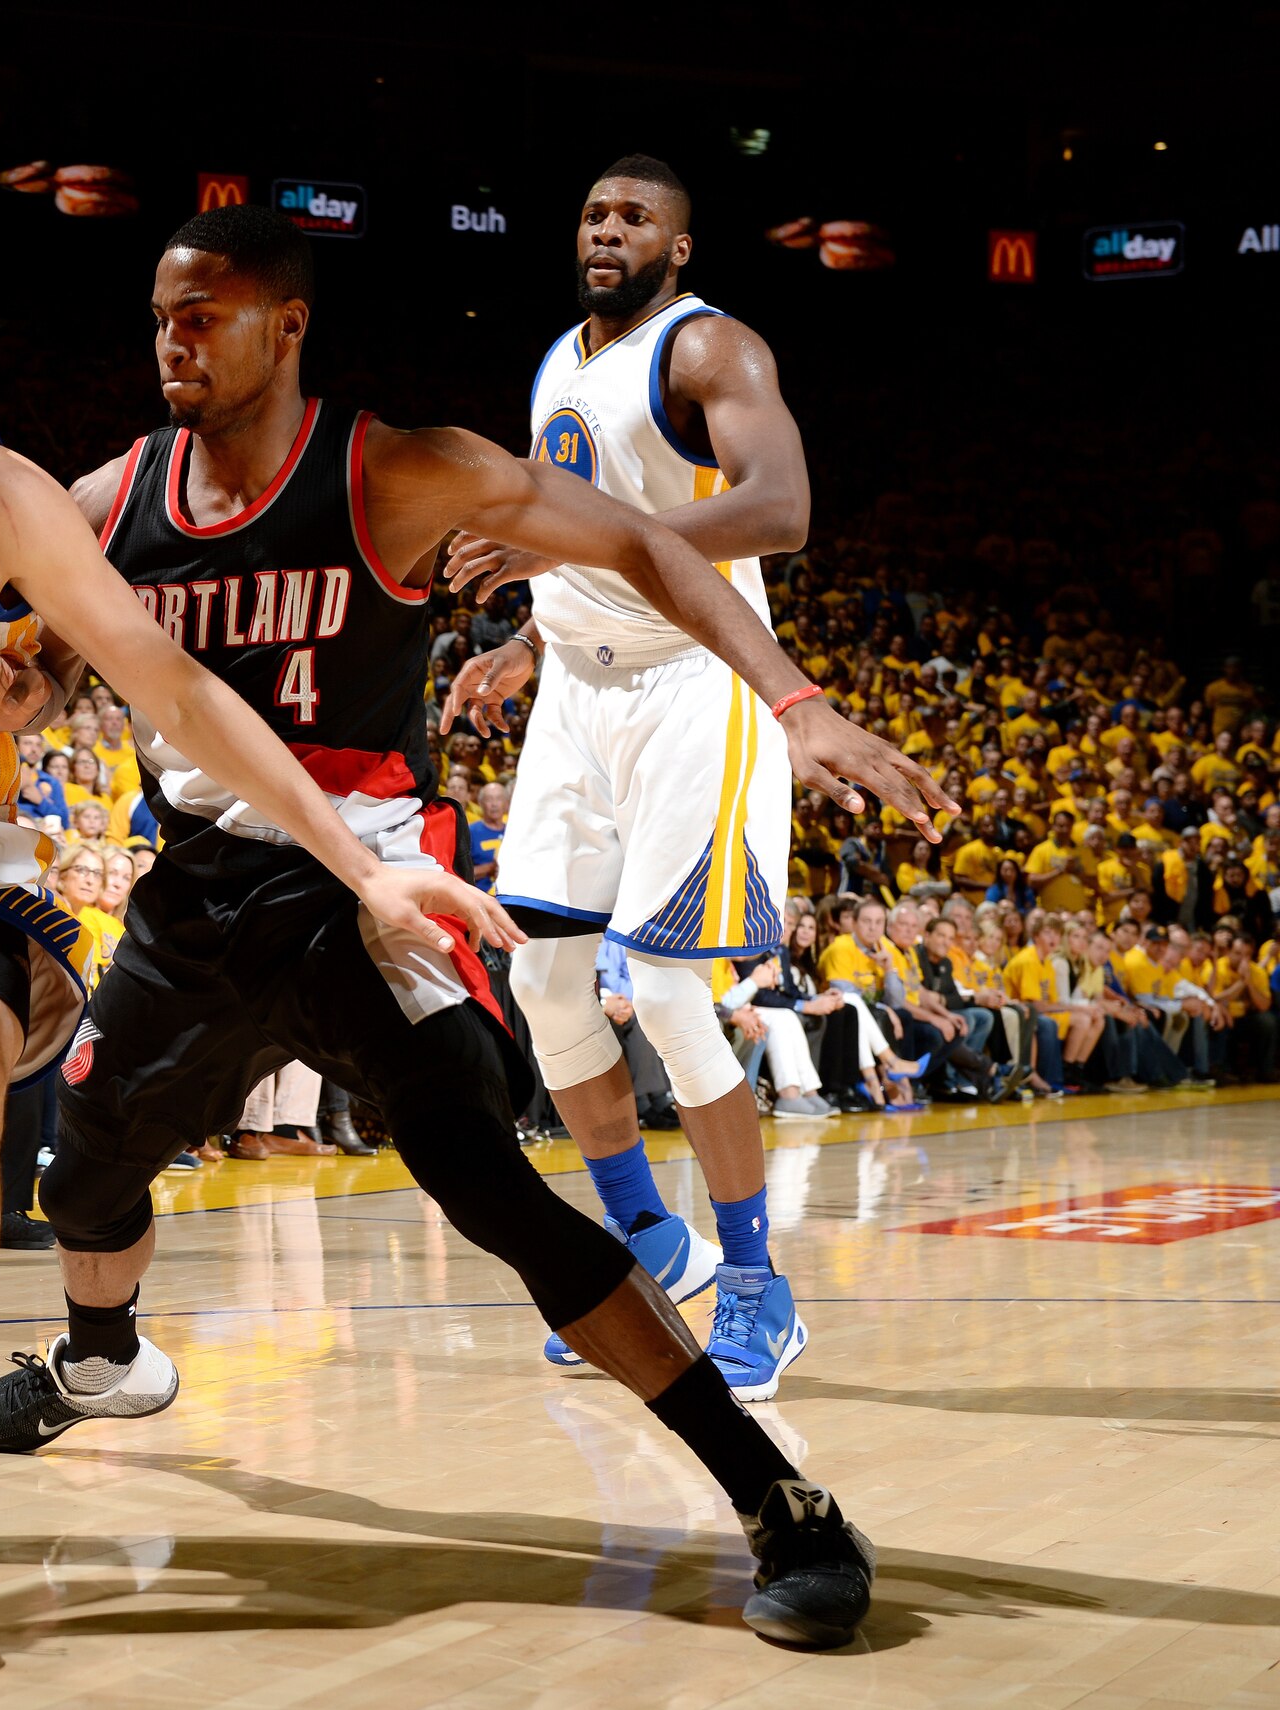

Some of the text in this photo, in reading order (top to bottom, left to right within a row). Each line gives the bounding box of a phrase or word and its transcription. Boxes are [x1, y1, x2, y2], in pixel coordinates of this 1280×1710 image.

[280, 185, 314, 209] all
[308, 192, 358, 224] day
[451, 204, 507, 234] Buh
[1093, 229, 1177, 262] all day
[1237, 224, 1280, 254] All
[555, 431, 579, 464] 31
[274, 647, 320, 725] 4
